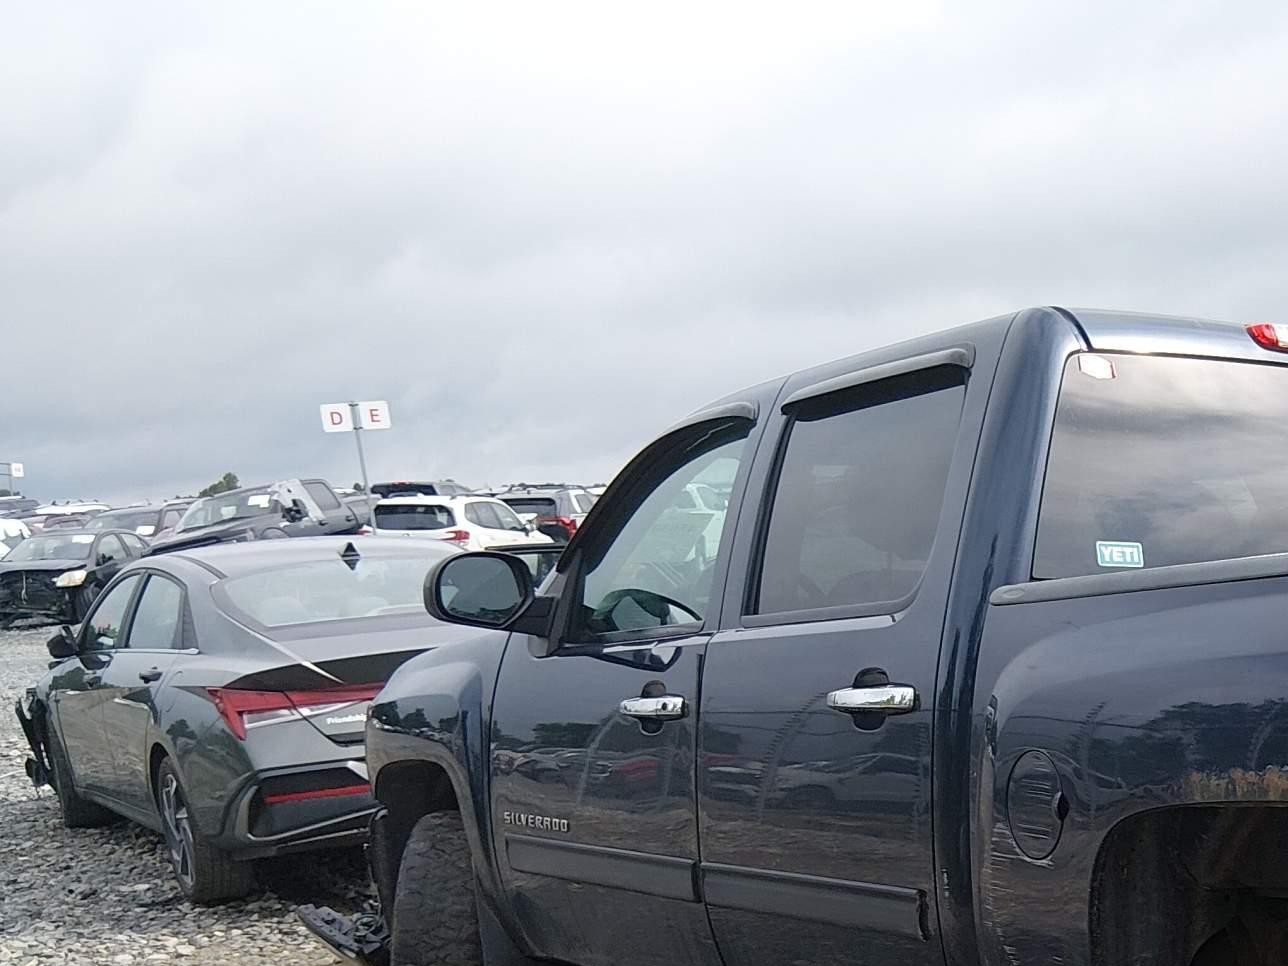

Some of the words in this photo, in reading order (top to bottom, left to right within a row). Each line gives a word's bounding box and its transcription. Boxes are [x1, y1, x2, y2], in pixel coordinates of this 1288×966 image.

[330, 411, 344, 426] D
[369, 408, 382, 423] E
[1100, 545, 1140, 563] YETI
[503, 811, 570, 833] SILVERADO
